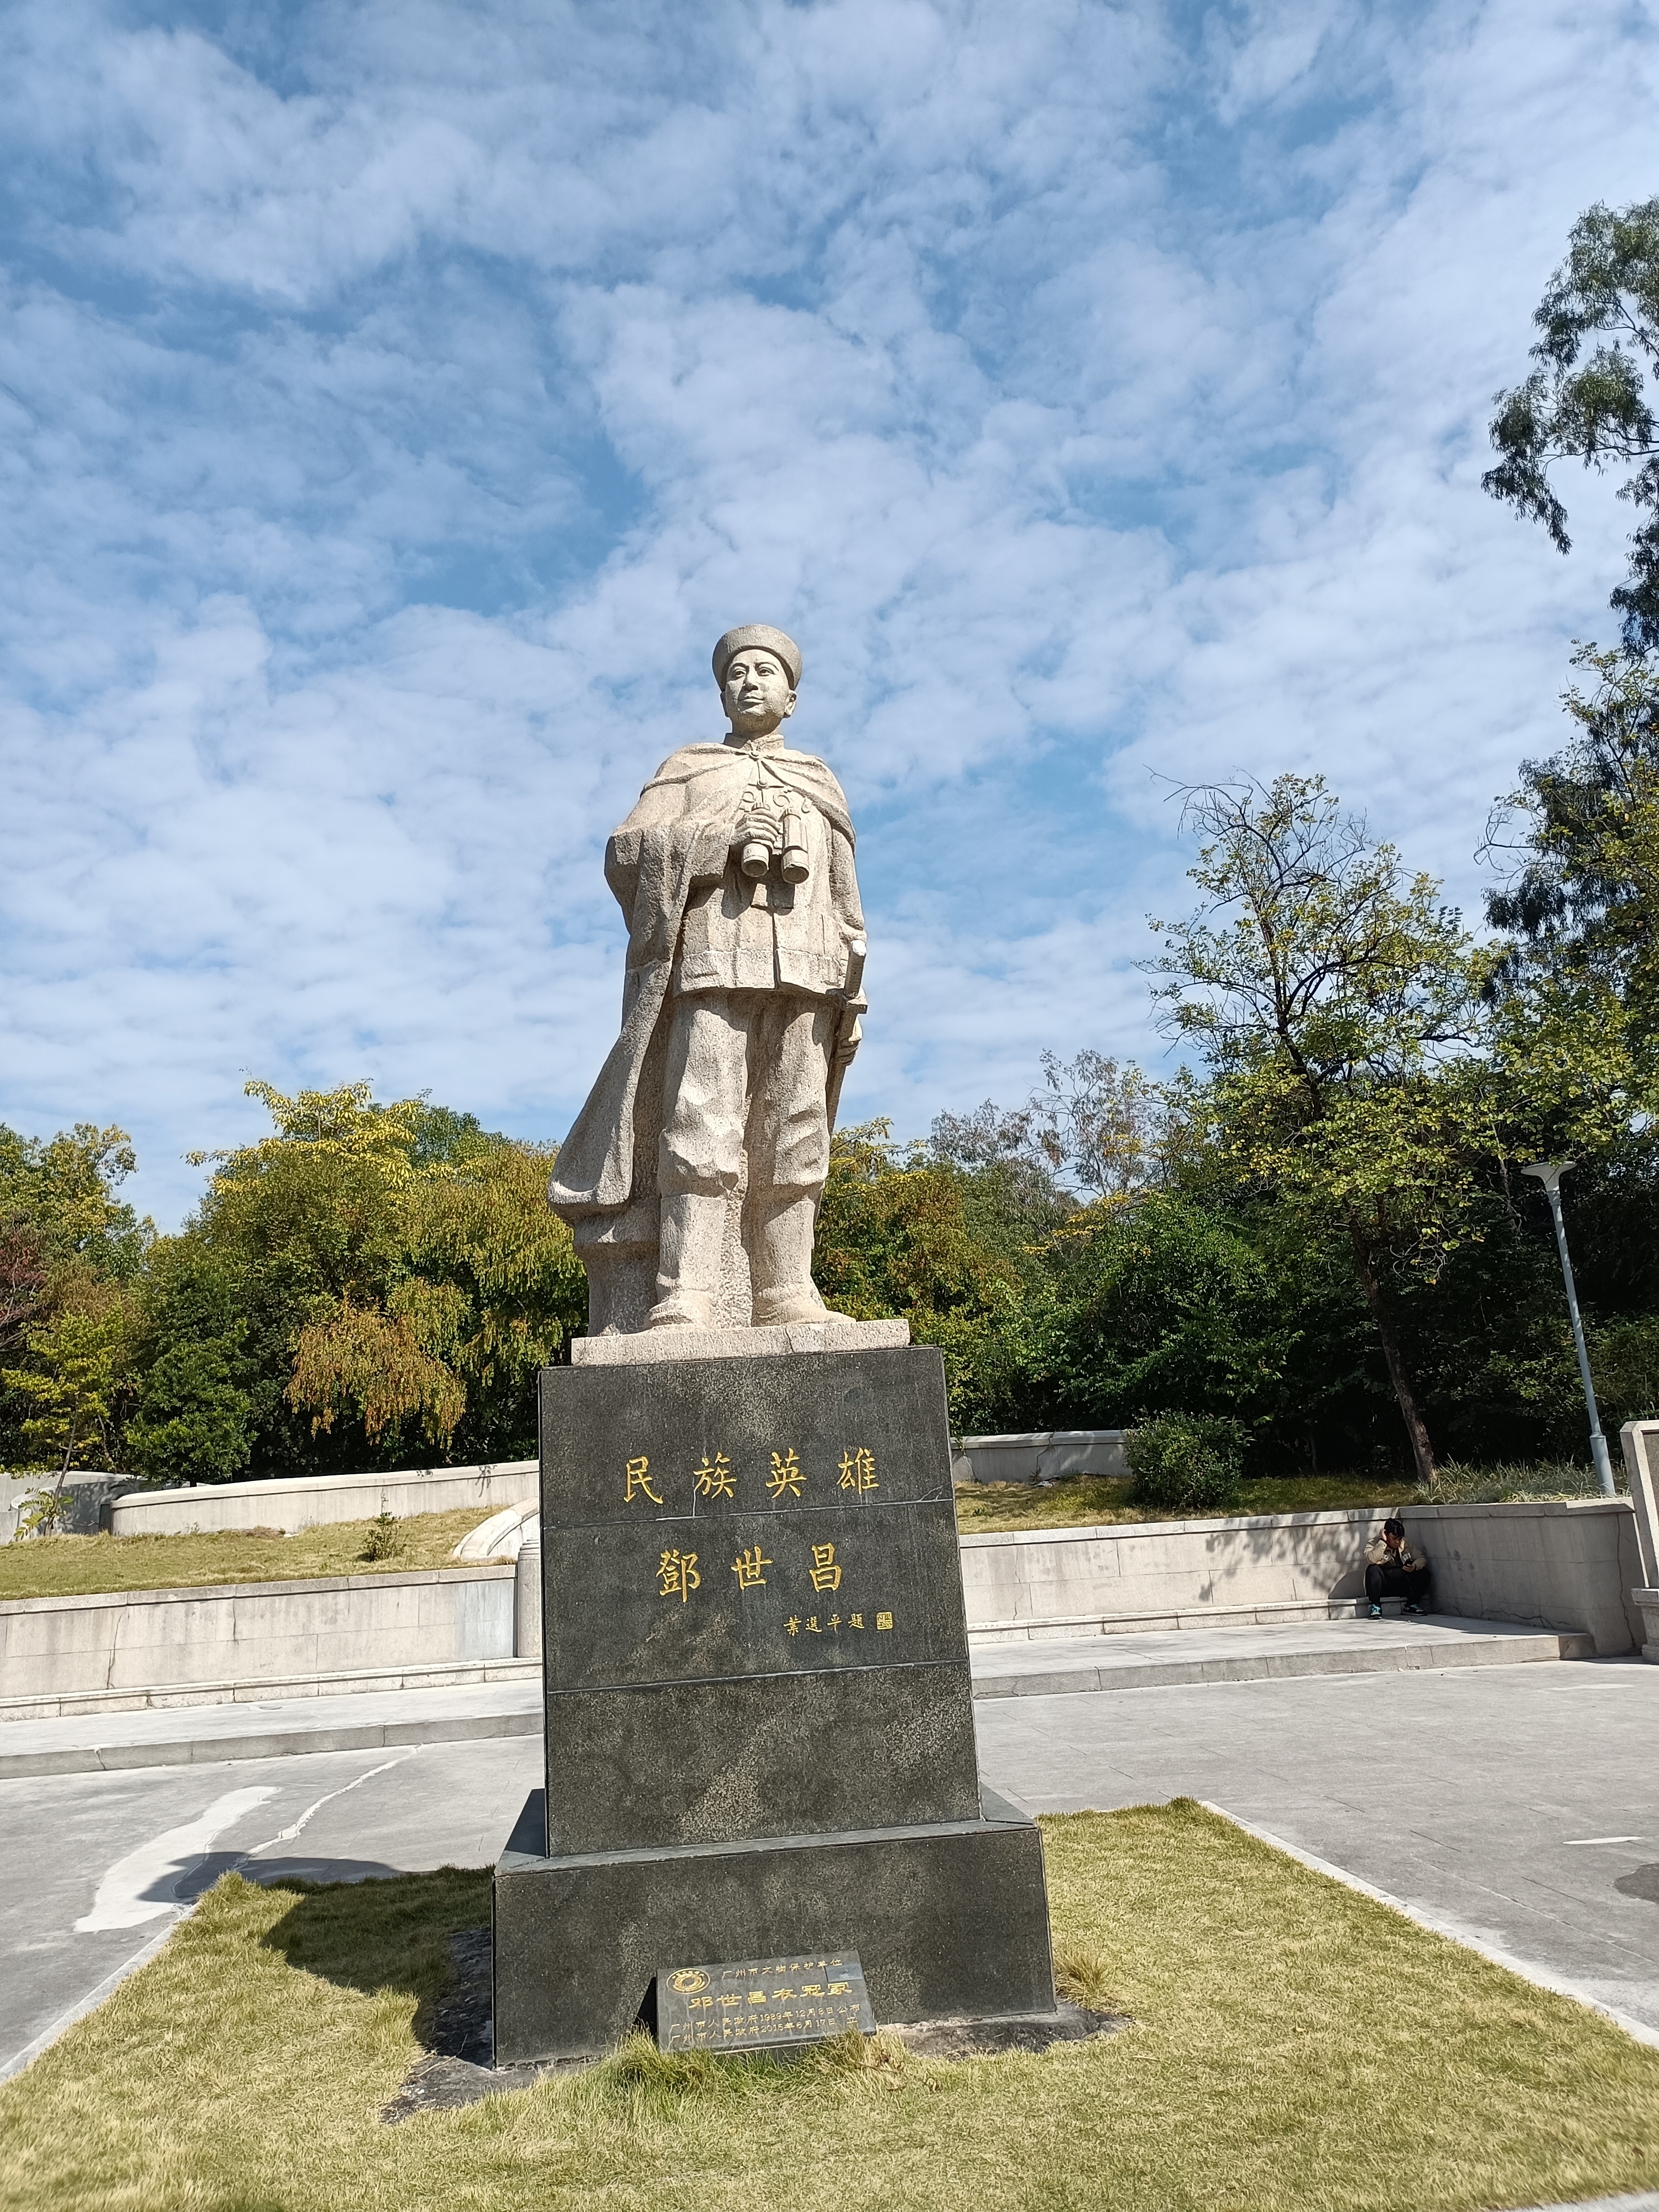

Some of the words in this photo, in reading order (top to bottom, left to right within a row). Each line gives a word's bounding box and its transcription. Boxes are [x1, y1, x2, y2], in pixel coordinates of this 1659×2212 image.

[623, 1447, 880, 1504] 民族英雄
[656, 1542, 842, 1603] 鄧世昌
[721, 1958, 843, 1980] 广州市文物保护单位
